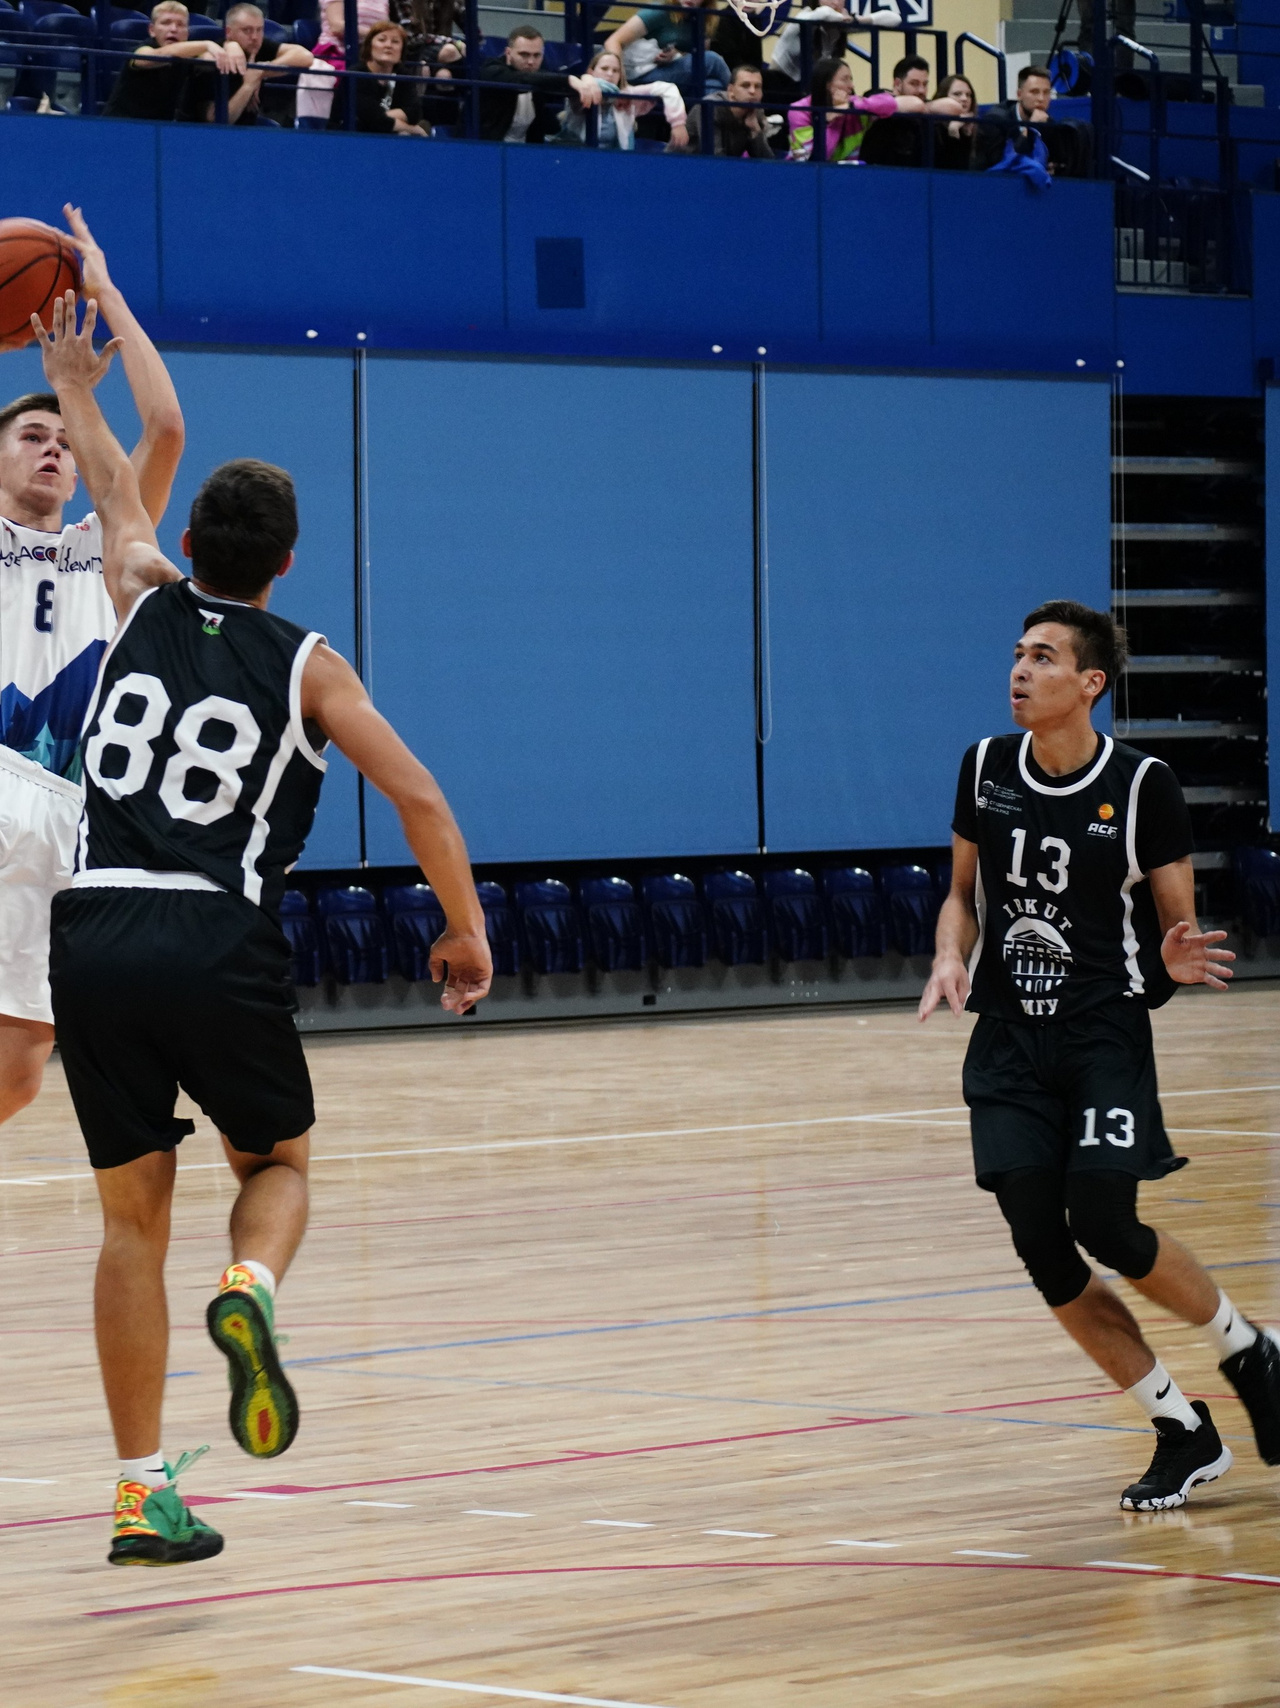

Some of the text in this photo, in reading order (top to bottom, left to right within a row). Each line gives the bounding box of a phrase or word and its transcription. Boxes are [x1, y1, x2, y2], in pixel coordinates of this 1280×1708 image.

[85, 672, 262, 826] 88
[1006, 828, 1071, 894] 13
[1002, 898, 1073, 931] IRKUT
[1079, 1107, 1135, 1148] 13
